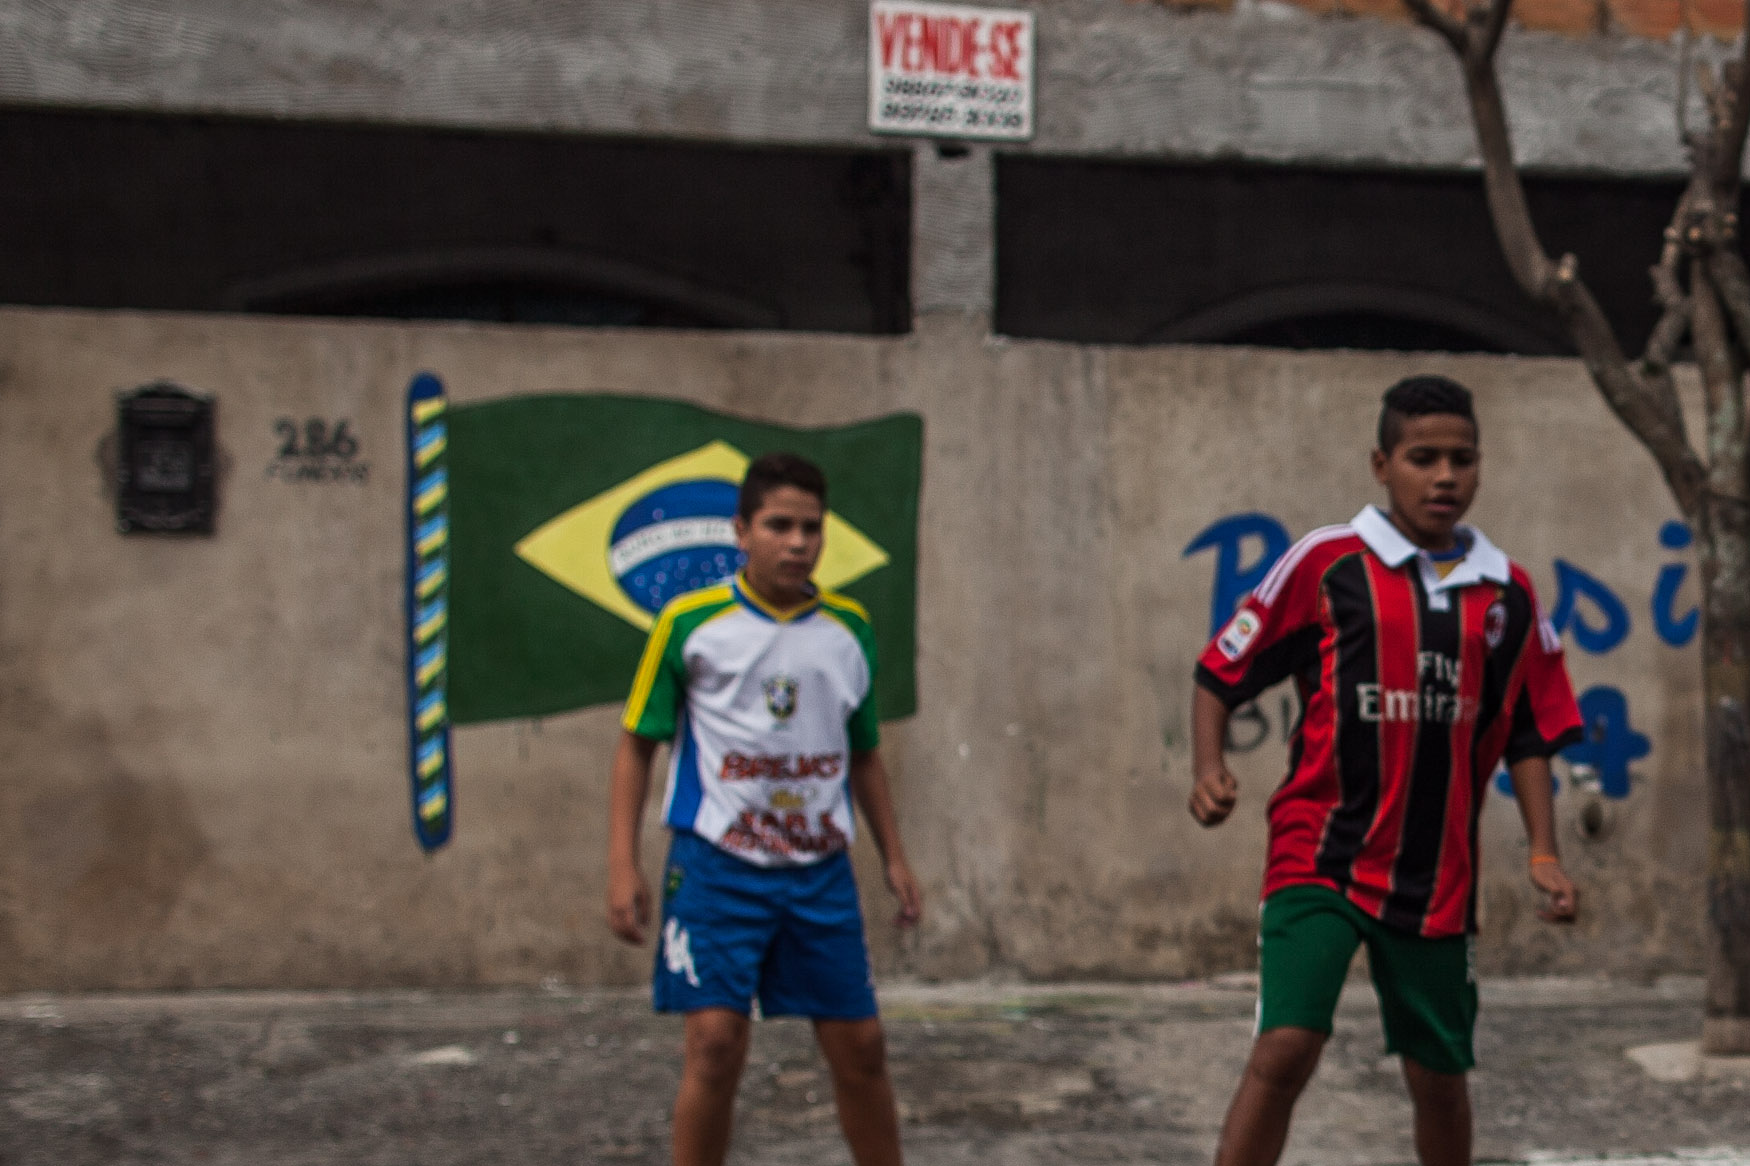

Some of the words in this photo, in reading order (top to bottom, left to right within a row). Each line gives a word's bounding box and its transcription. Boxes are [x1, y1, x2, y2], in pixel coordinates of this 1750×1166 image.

[876, 12, 1022, 80] VENDE-SE
[273, 417, 358, 458] 286
[1417, 651, 1462, 688] Fly
[1356, 683, 1476, 721] Emira
